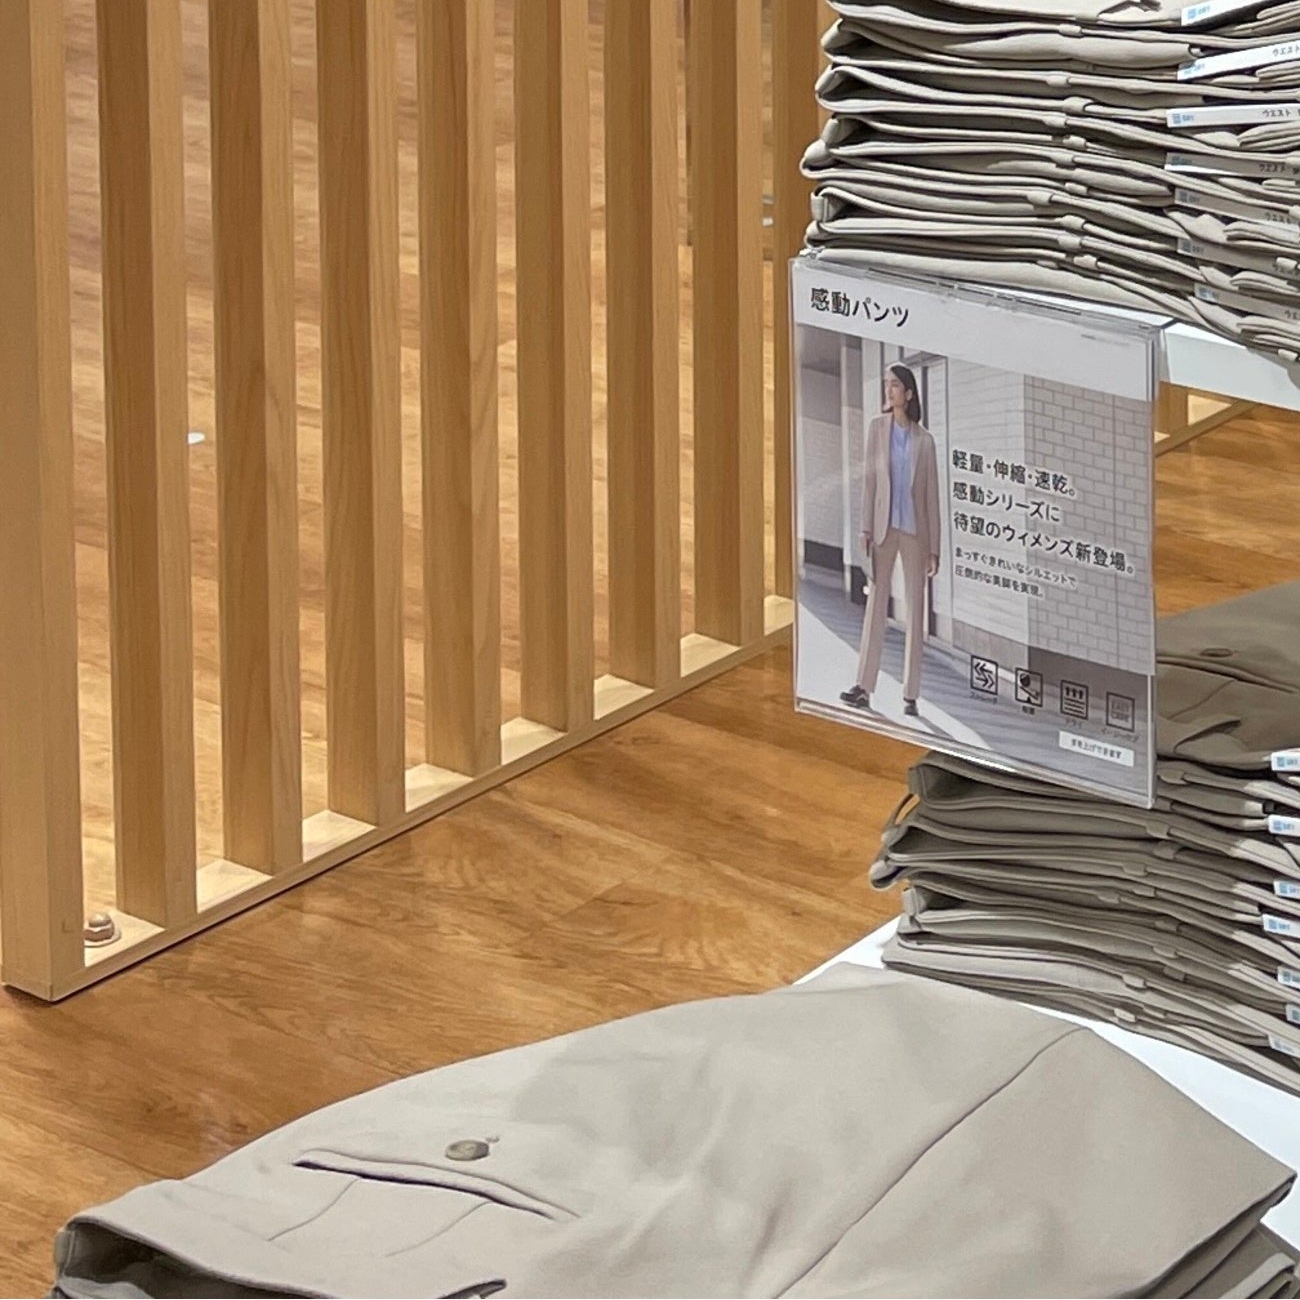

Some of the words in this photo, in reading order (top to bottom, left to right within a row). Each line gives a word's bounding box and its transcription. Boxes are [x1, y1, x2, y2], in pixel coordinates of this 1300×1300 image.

[809, 286, 910, 329] 感動パンツ
[952, 449, 1076, 498] 軽量・伸縮・速乾。
[952, 481, 1061, 523] 感動シリーズに
[953, 510, 1135, 575] 待望のウィメンズ新登場。
